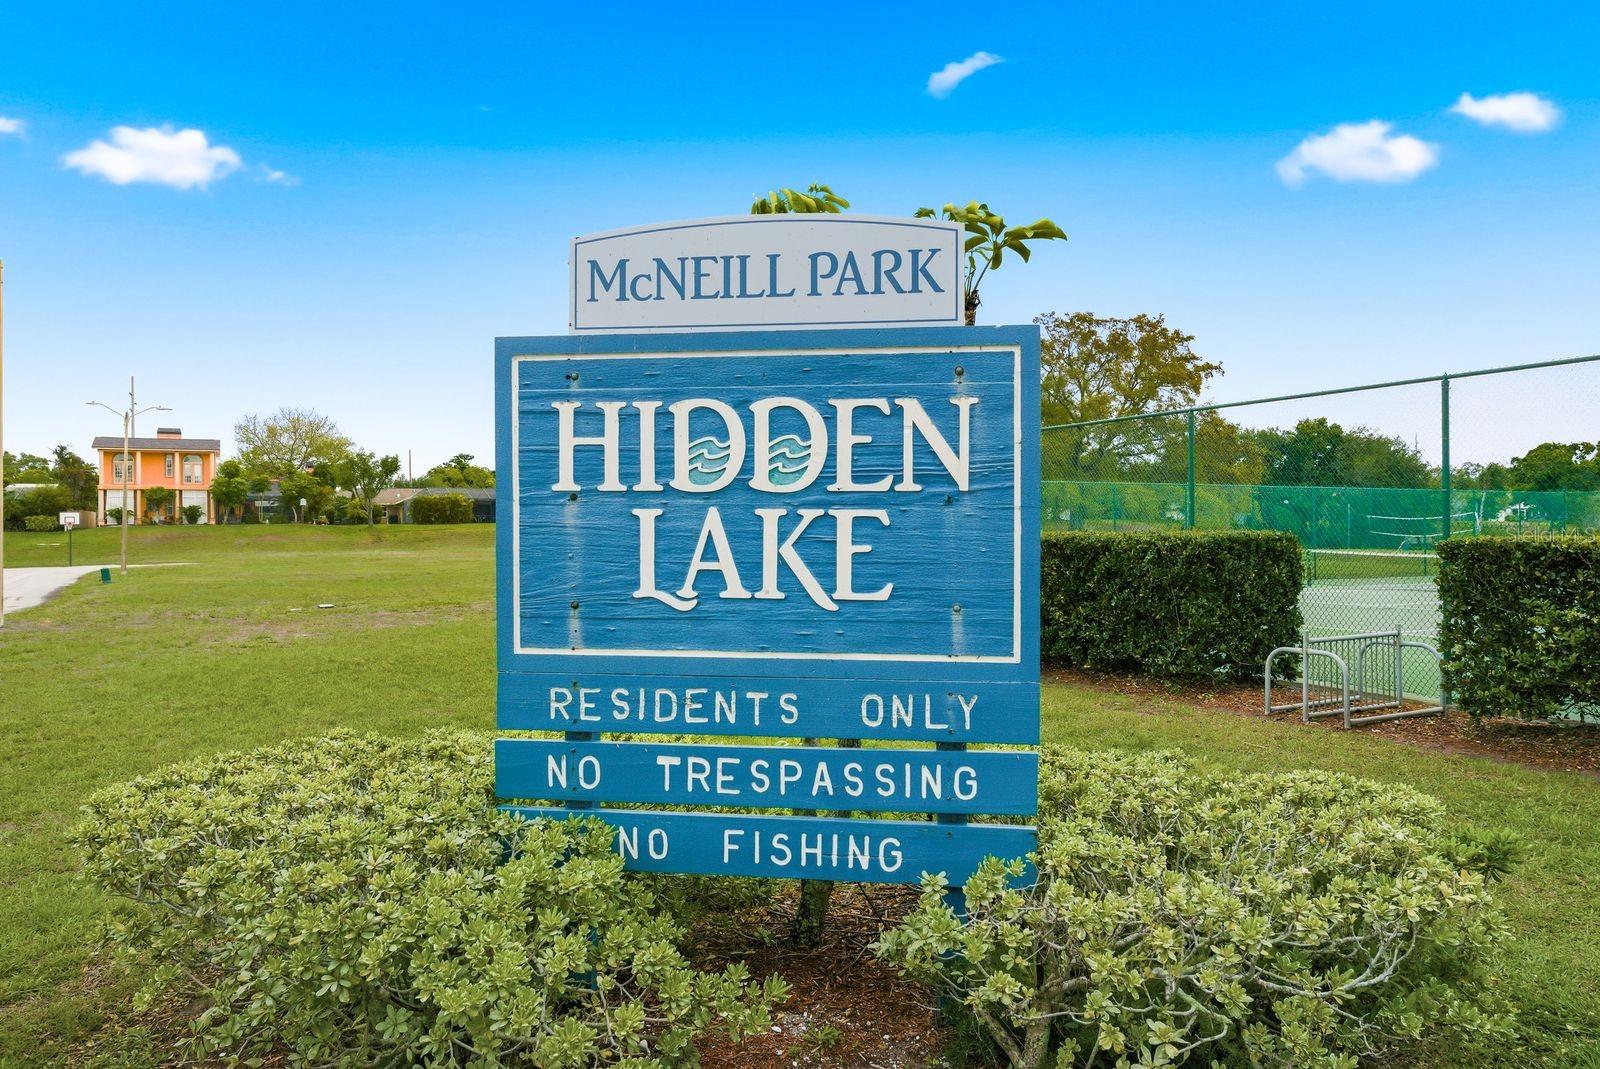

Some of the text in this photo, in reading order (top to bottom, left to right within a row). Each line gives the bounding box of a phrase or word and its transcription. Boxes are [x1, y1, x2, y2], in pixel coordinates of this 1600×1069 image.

[587, 246, 945, 302] McNEILL PARK
[551, 397, 979, 493] HIDDEN
[631, 506, 895, 612] LAKE
[549, 687, 979, 731] RESIDENTS ONLY
[547, 754, 979, 801] NO TRESPASSING
[617, 827, 904, 873] NO FISHING
